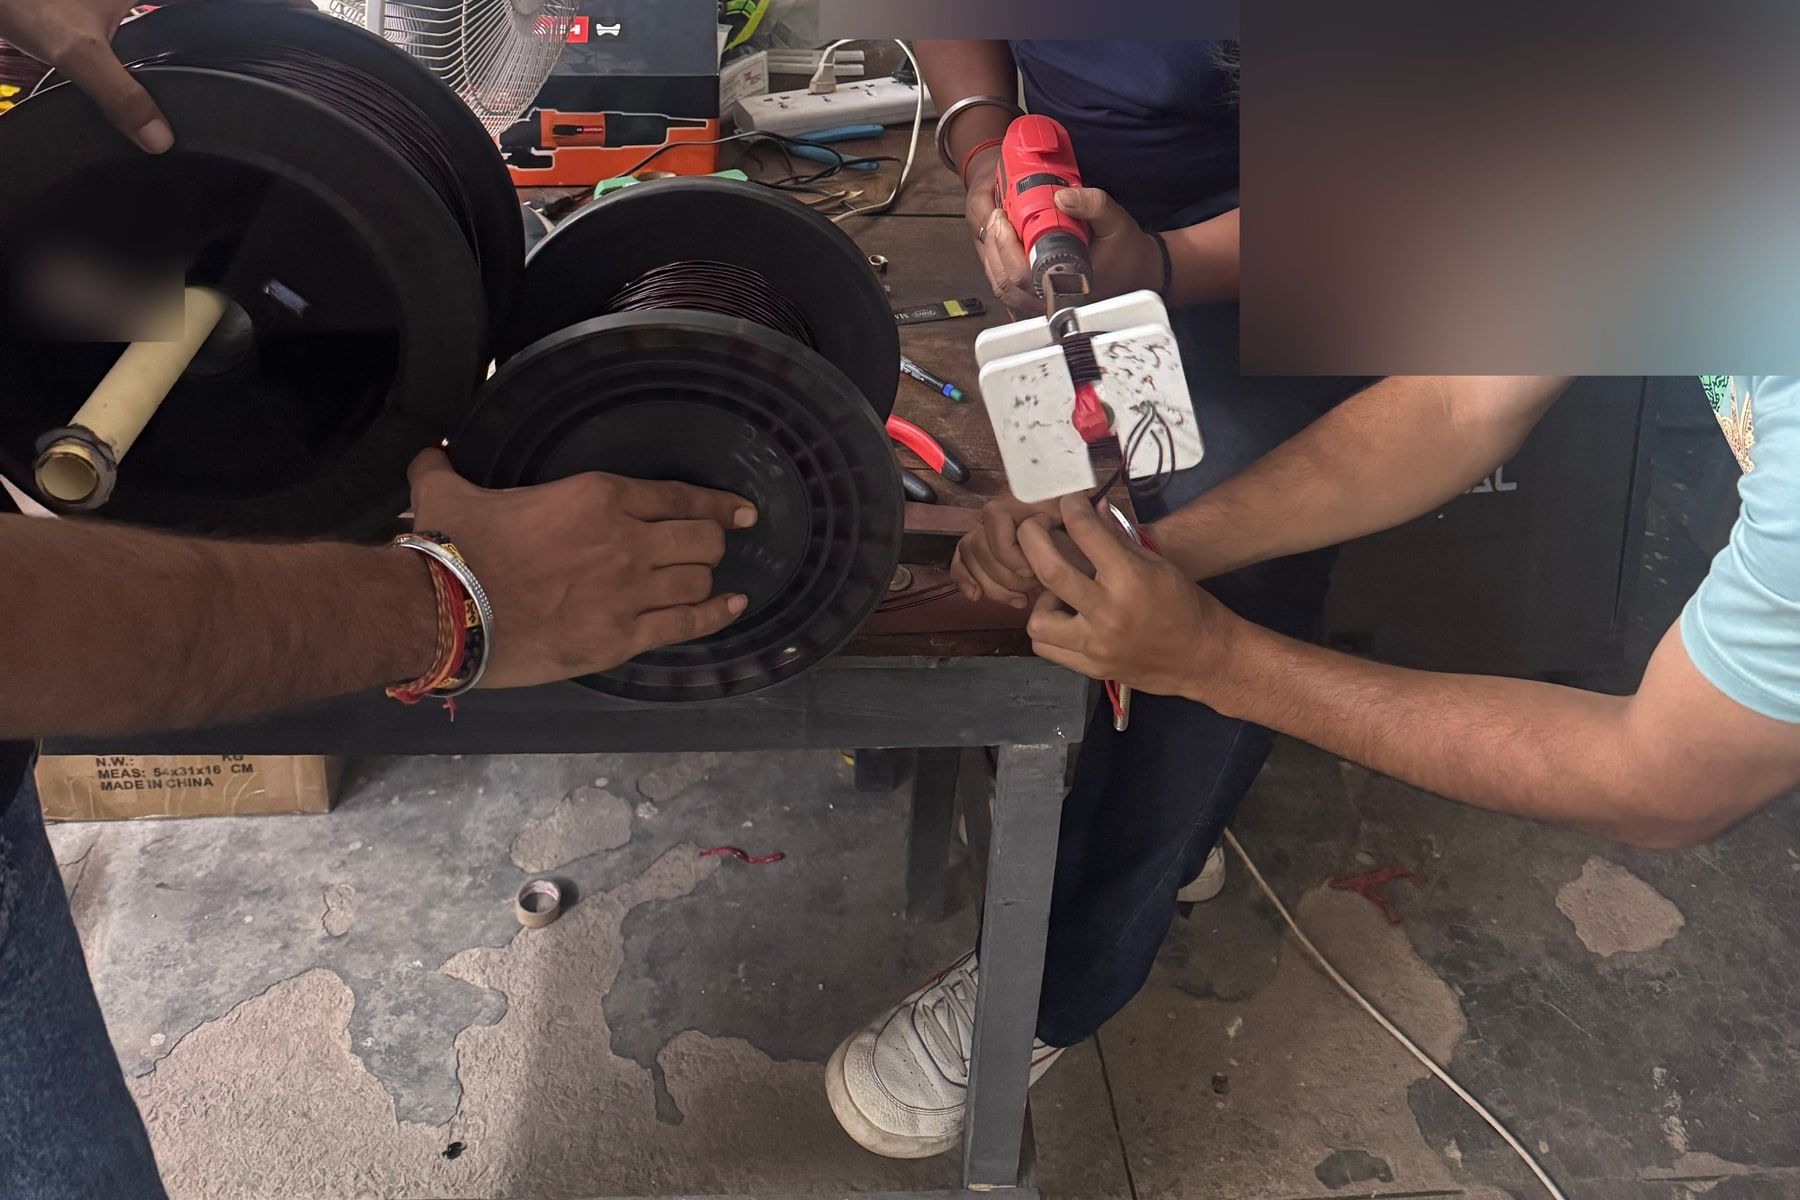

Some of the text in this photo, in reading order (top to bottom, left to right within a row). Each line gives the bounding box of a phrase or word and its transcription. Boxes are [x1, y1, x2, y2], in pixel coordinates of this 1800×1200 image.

[96, 756, 134, 767] N.W.:
[98, 768, 146, 779] MEAS:
[231, 763, 253, 774] CM
[100, 777, 214, 792] MADE IN CHINA
